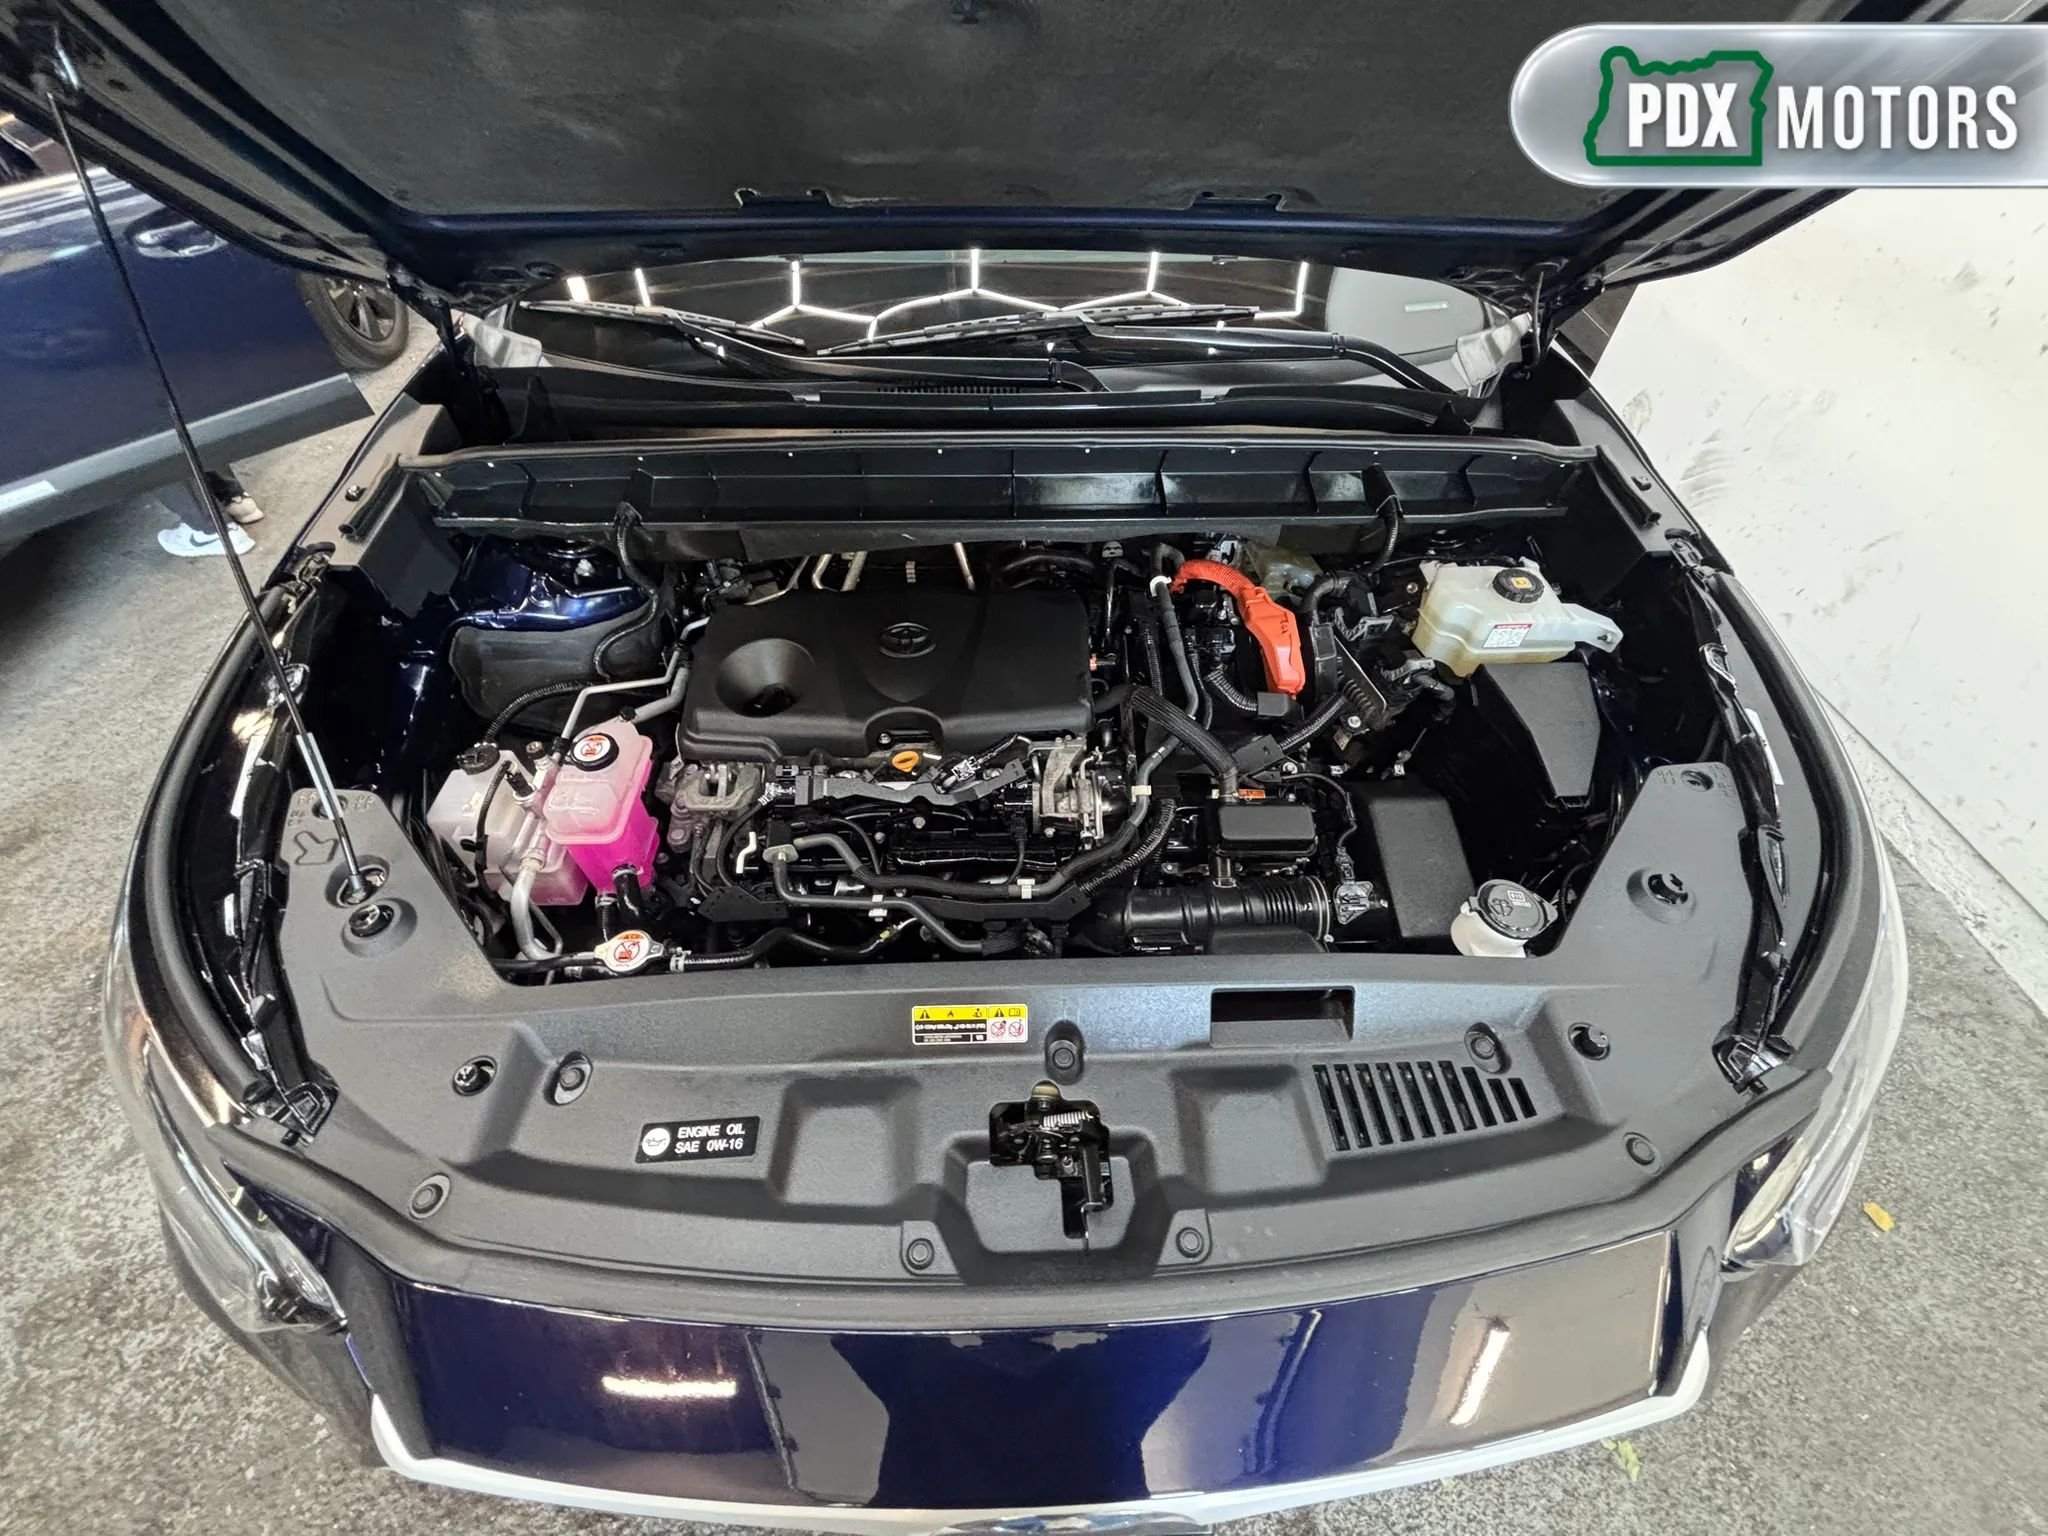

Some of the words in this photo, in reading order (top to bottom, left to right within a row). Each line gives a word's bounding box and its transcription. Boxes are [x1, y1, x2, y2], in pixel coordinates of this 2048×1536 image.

[677, 1124, 721, 1139] ENGINE
[726, 1123, 745, 1136] OIL
[674, 1140, 700, 1154] SAE
[706, 1138, 744, 1152] 0W-16
